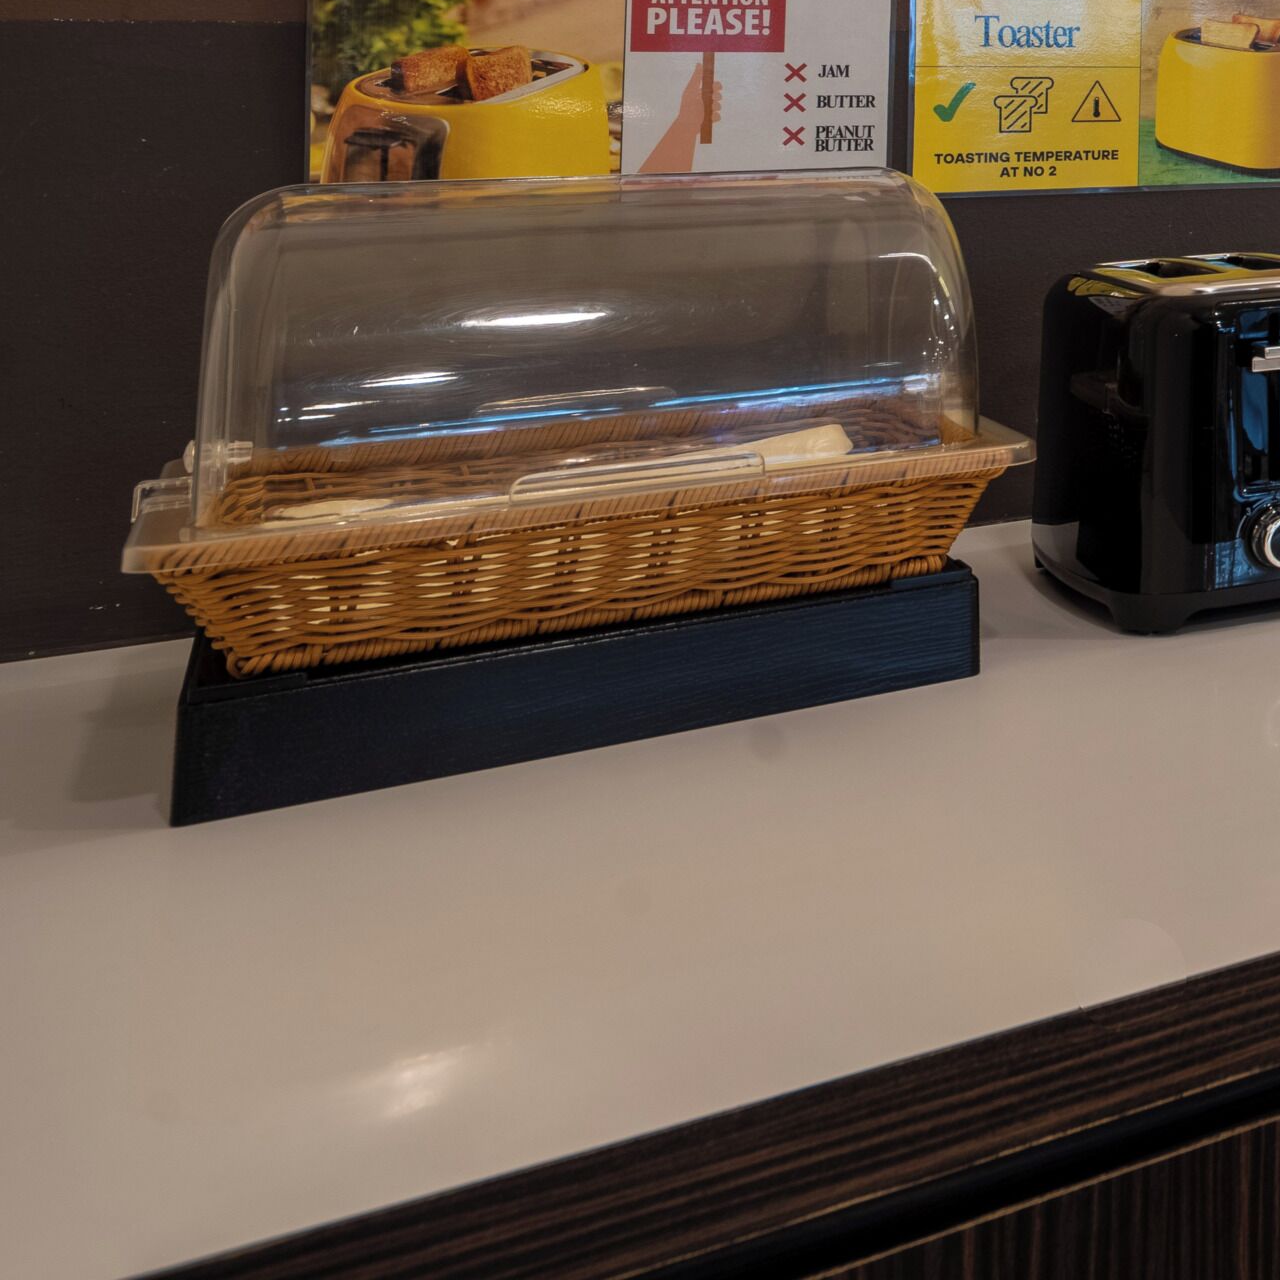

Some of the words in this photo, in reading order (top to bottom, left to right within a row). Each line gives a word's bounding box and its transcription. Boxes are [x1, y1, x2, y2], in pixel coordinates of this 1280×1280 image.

[646, 7, 771, 36] PLEASE!
[974, 15, 1081, 48] Toaster
[818, 64, 850, 78] JAM
[816, 95, 876, 108] BUTTER
[815, 125, 876, 139] PEANUT
[814, 139, 874, 152] BUTTER
[934, 152, 1010, 165] TOASTING
[1014, 149, 1120, 163] TEMPERATURE
[1000, 167, 1019, 178] AT
[1023, 166, 1045, 177] NO
[1048, 166, 1057, 176] 2
